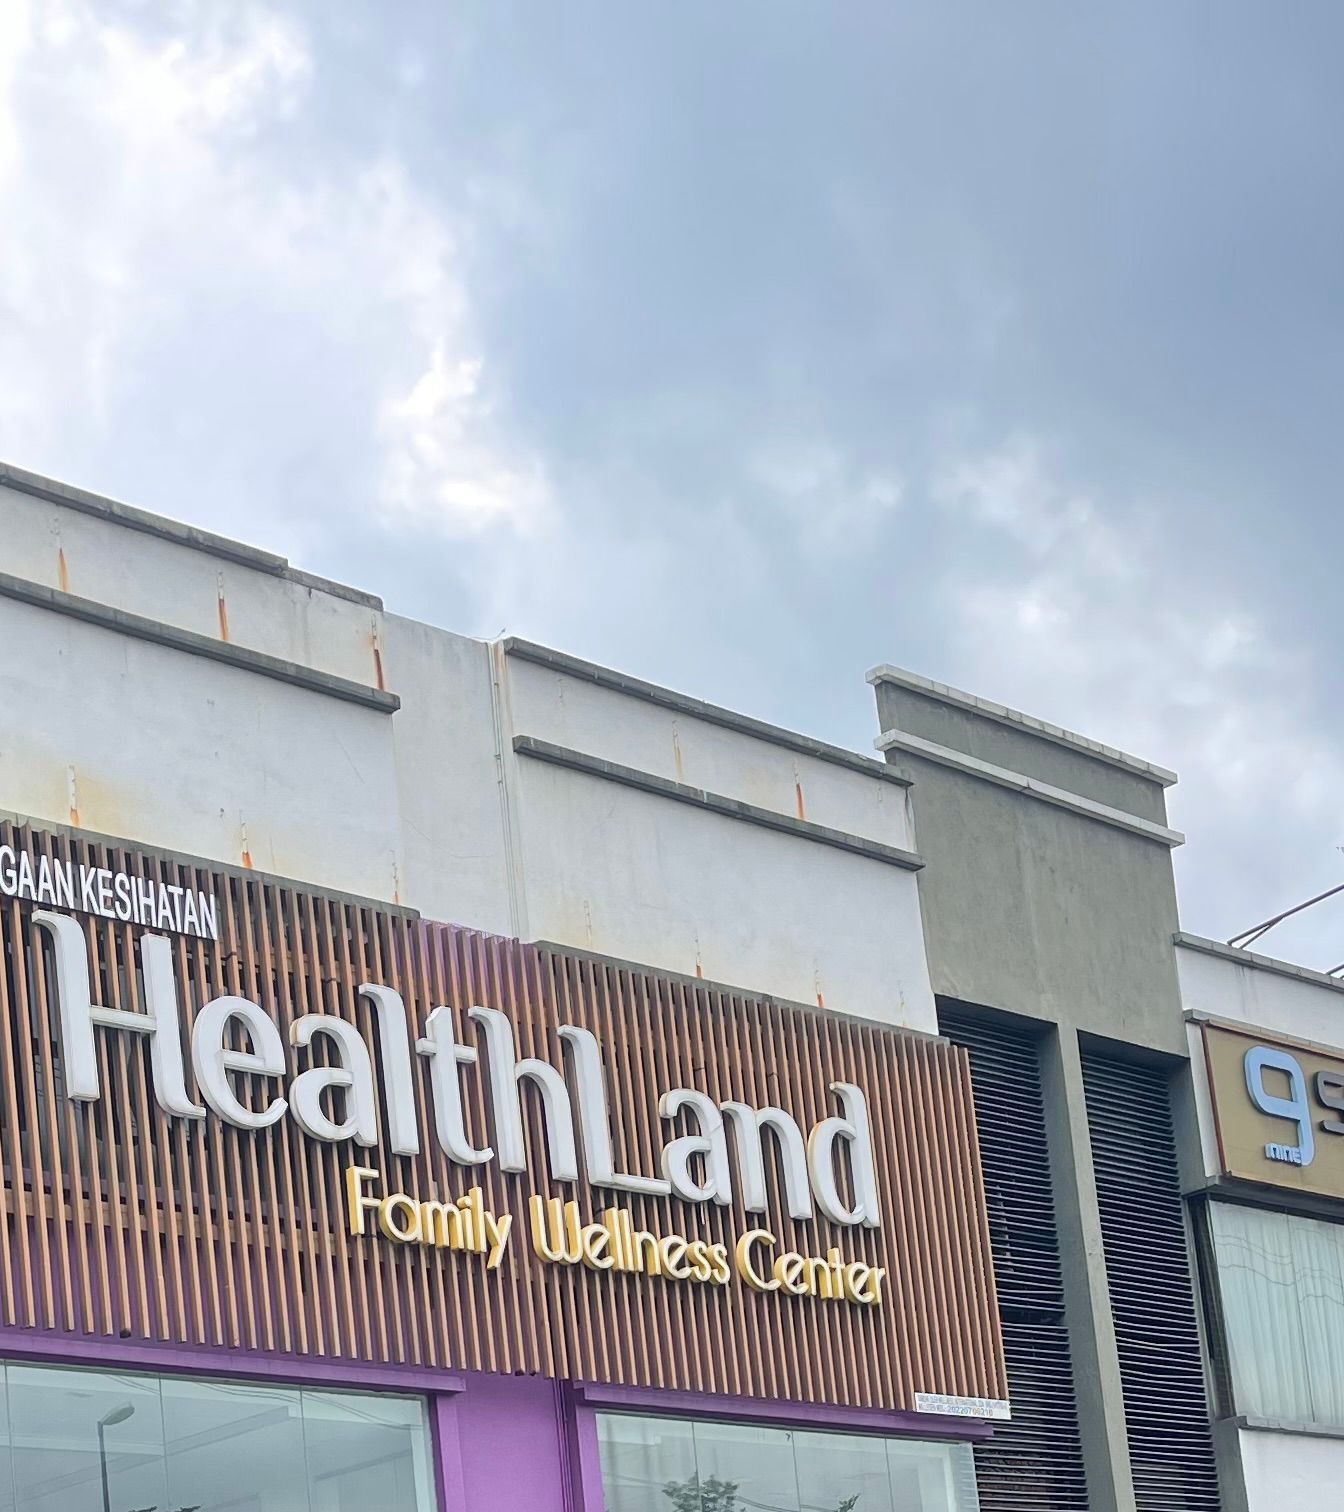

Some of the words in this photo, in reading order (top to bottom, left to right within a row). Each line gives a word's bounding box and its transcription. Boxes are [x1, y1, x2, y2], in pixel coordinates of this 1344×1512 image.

[80, 862, 219, 941] KESIHATAN
[31, 909, 881, 1229] HealthLand
[1243, 1045, 1316, 1167] 9
[344, 1164, 513, 1271] Family
[528, 1193, 732, 1286] Wellness
[735, 1227, 886, 1306] Center
